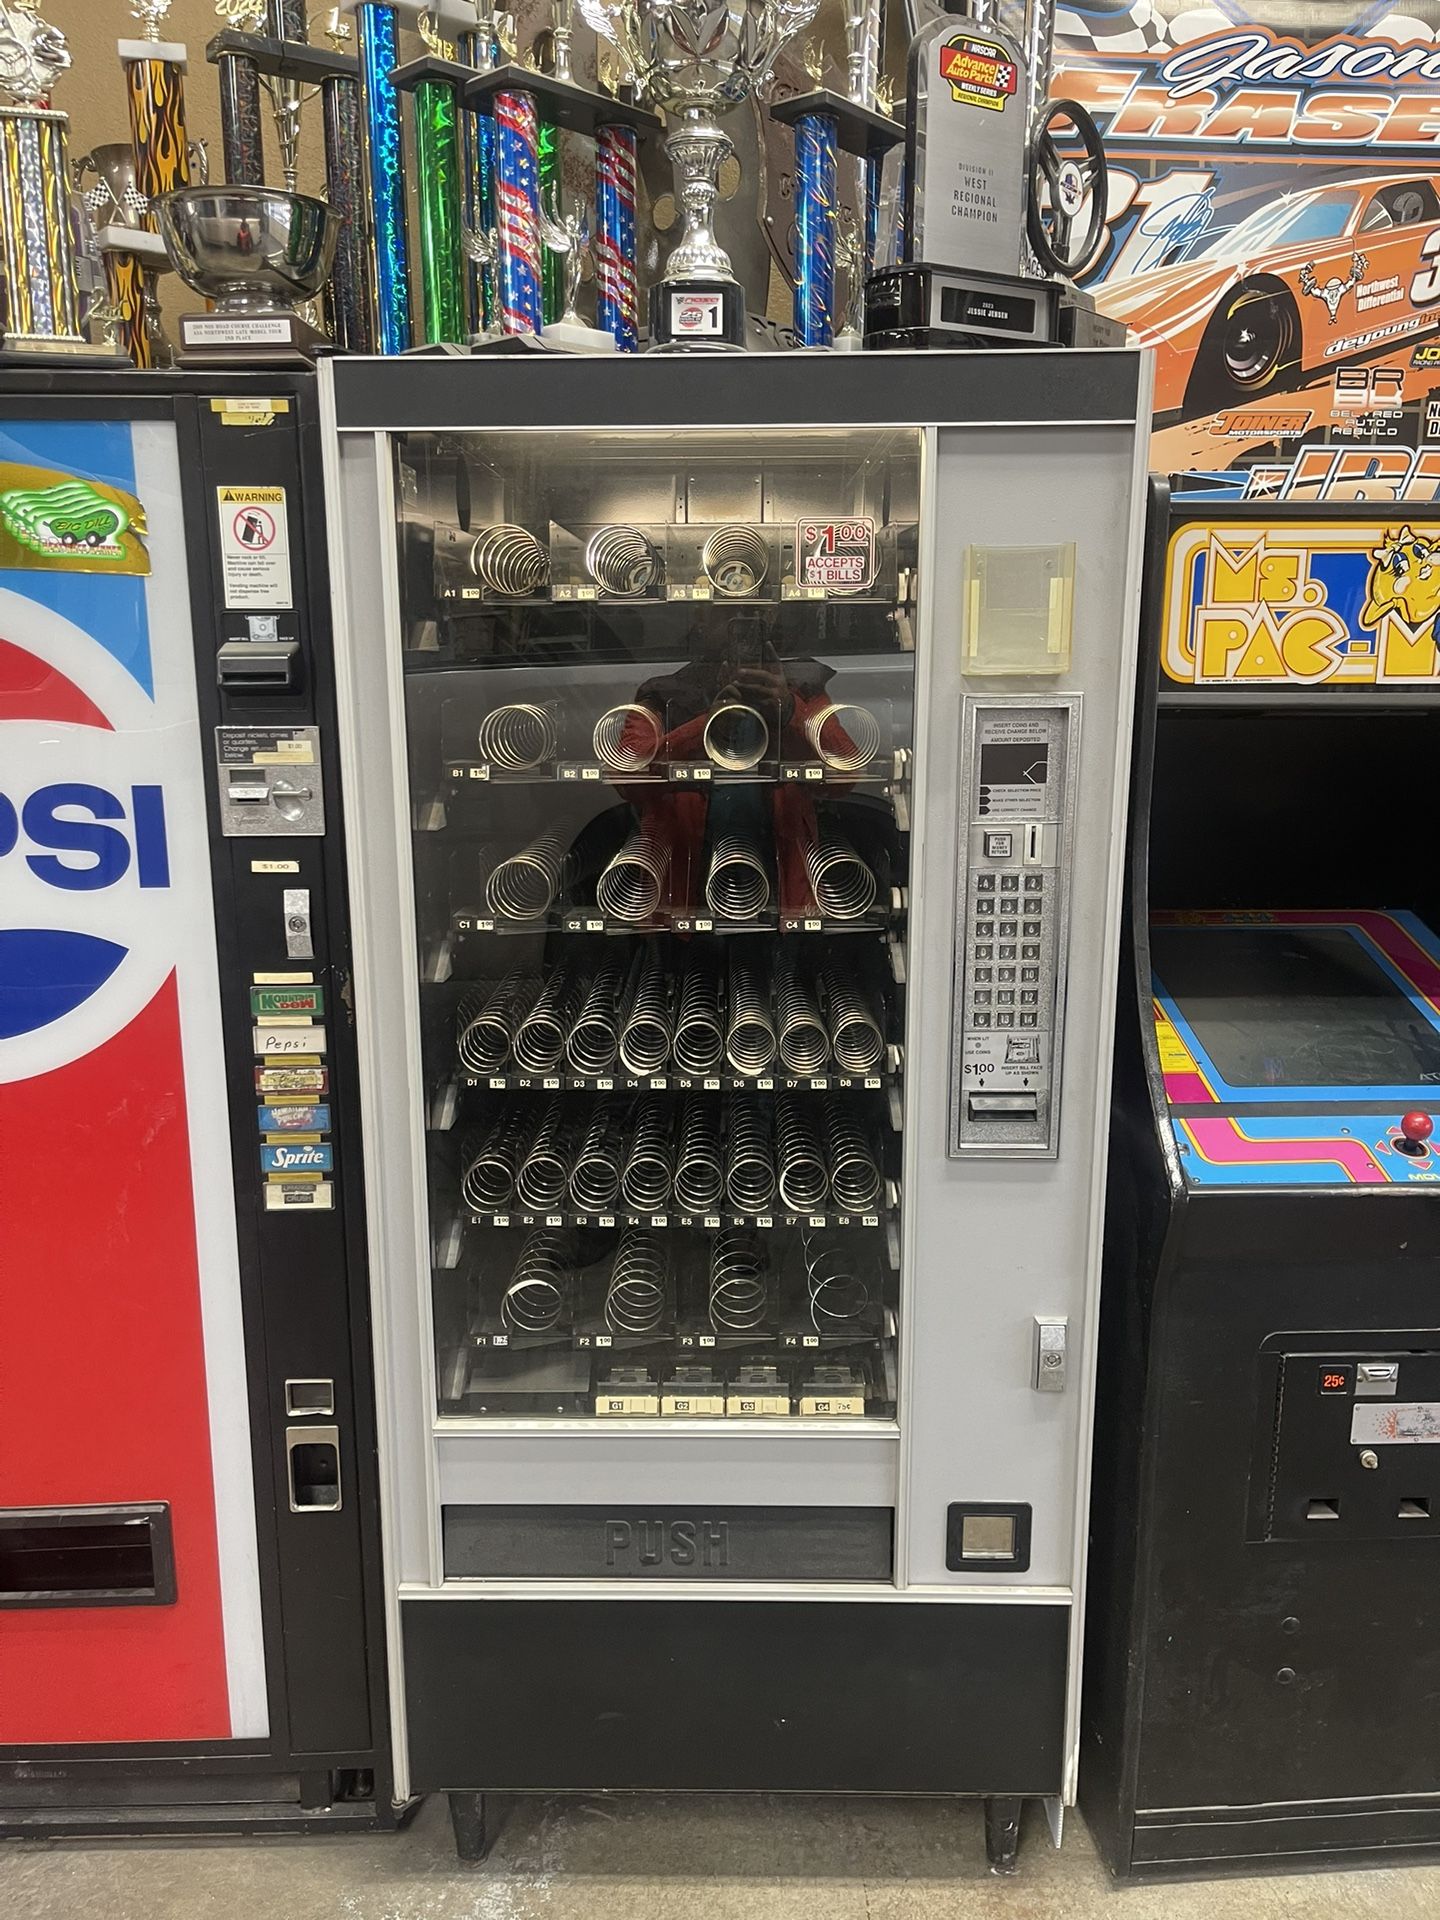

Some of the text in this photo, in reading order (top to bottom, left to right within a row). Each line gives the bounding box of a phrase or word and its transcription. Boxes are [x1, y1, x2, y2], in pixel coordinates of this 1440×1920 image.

[215, 0, 264, 15] 2024
[329, 7, 350, 36] 1st
[971, 43, 997, 58] NASCAR
[951, 53, 995, 74] Advance
[946, 64, 993, 84] Auto Parts
[980, 86, 997, 97] SERIES
[958, 162, 986, 174] DIVISION
[964, 176, 987, 190] WEST
[953, 190, 997, 208] REGIONAL
[951, 204, 998, 223] CHAMPION
[1356, 274, 1399, 298] Northwest
[1357, 286, 1404, 312] Differential
[708, 306, 718, 328] 1
[967, 307, 987, 317] JESSIE
[1372, 410, 1403, 418] RED
[1209, 410, 1311, 435] JOINER
[1345, 418, 1386, 427] AUTO
[1332, 427, 1398, 436] REBUILD
[234, 492, 282, 502] WARNING
[55, 516, 111, 531] BIG DILL
[807, 557, 864, 568] ACCEPTS
[810, 570, 861, 580] $1 BILLS
[444, 590, 456, 598] A1
[559, 590, 571, 598] A2
[673, 590, 686, 598] A3
[788, 590, 801, 598] A4
[459, 921, 470, 929] C1
[568, 921, 581, 929] C2
[677, 921, 689, 929] C3
[786, 921, 798, 929] C4
[266, 1036, 307, 1051] Pepsi
[964, 1063, 995, 1076] $1.00
[467, 1079, 478, 1087] D1
[519, 1079, 531, 1087] D2
[573, 1080, 585, 1088] D3
[627, 1080, 639, 1088] D4
[680, 1080, 692, 1088] D5
[733, 1080, 745, 1088] D6
[787, 1080, 798, 1088] D7
[840, 1079, 852, 1087] D8
[271, 1145, 324, 1168] Sprite
[471, 1217, 482, 1225] E1
[523, 1217, 534, 1225] E2
[1323, 1374, 1345, 1388] 25¢
[606, 1520, 729, 1566] PUSH
